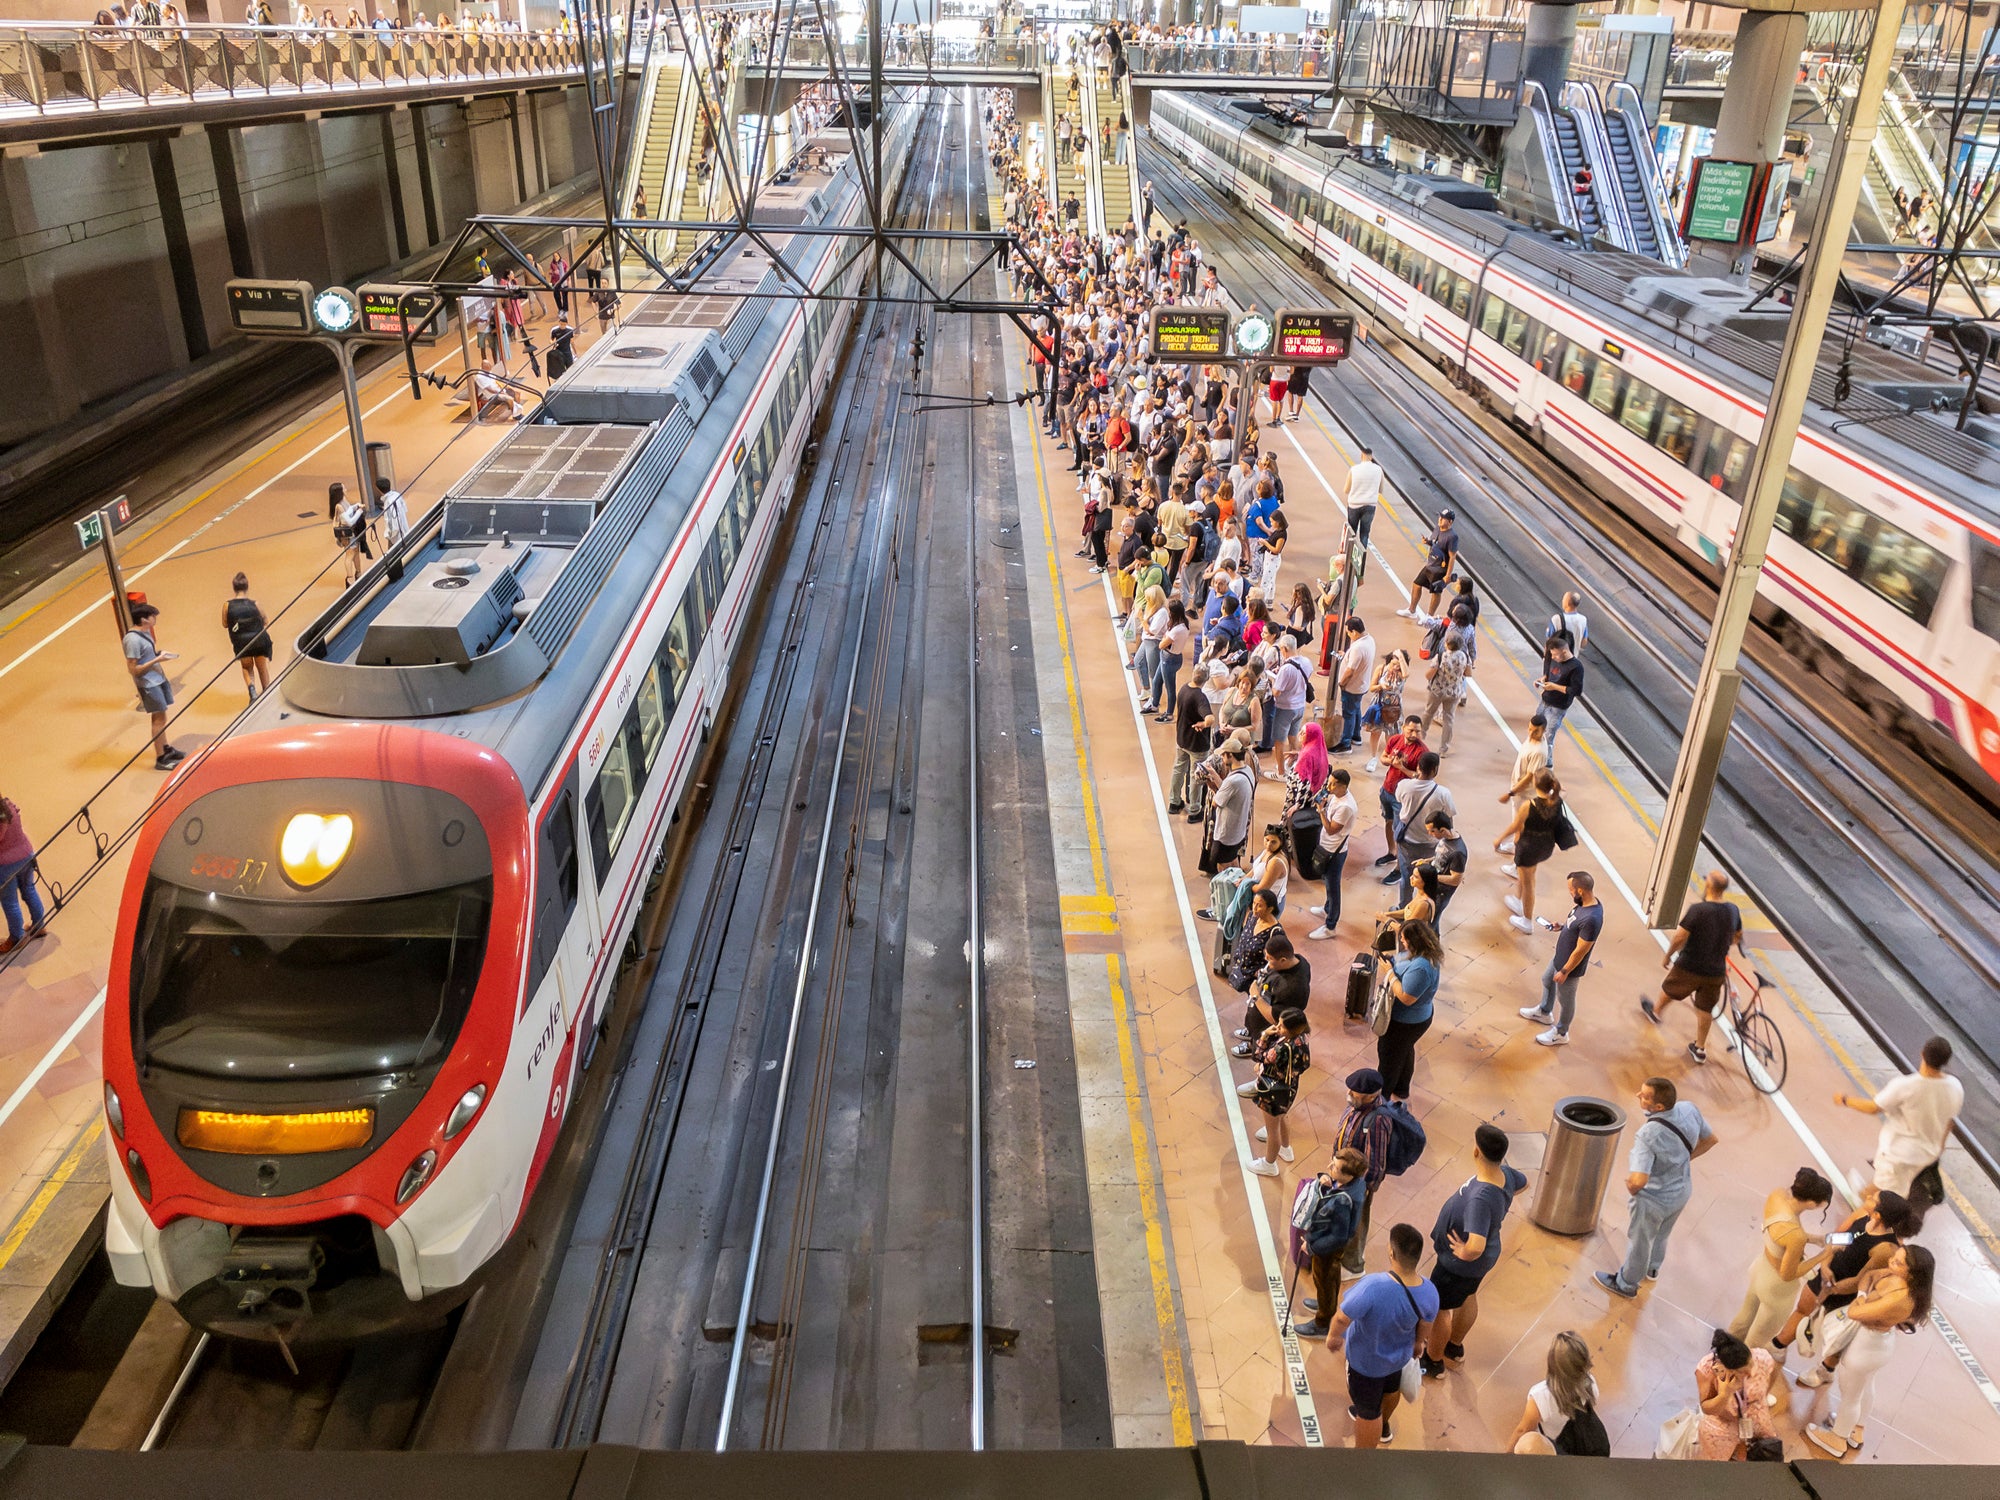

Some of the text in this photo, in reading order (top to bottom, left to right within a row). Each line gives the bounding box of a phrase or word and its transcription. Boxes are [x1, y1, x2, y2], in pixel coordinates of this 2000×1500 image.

[1704, 167, 1741, 177] Más vale
[1702, 176, 1731, 185] ladrillo
[1701, 186, 1742, 197] mano que
[1699, 193, 1722, 203] cripto
[1697, 203, 1730, 212] volando
[266, 290, 272, 299] 1
[1190, 316, 1196, 325] 3
[1313, 318, 1320, 327] 4
[1158, 326, 1200, 334] GUADALAJARA
[1298, 345, 1324, 353] PARADA
[616, 672, 632, 709] renfe
[527, 1000, 561, 1081] renfe
[1268, 1275, 1288, 1300] LINE
[1274, 1301, 1292, 1322] THE
[1290, 1366, 1310, 1396] KEEP
[1302, 1415, 1321, 1444] LINEA
